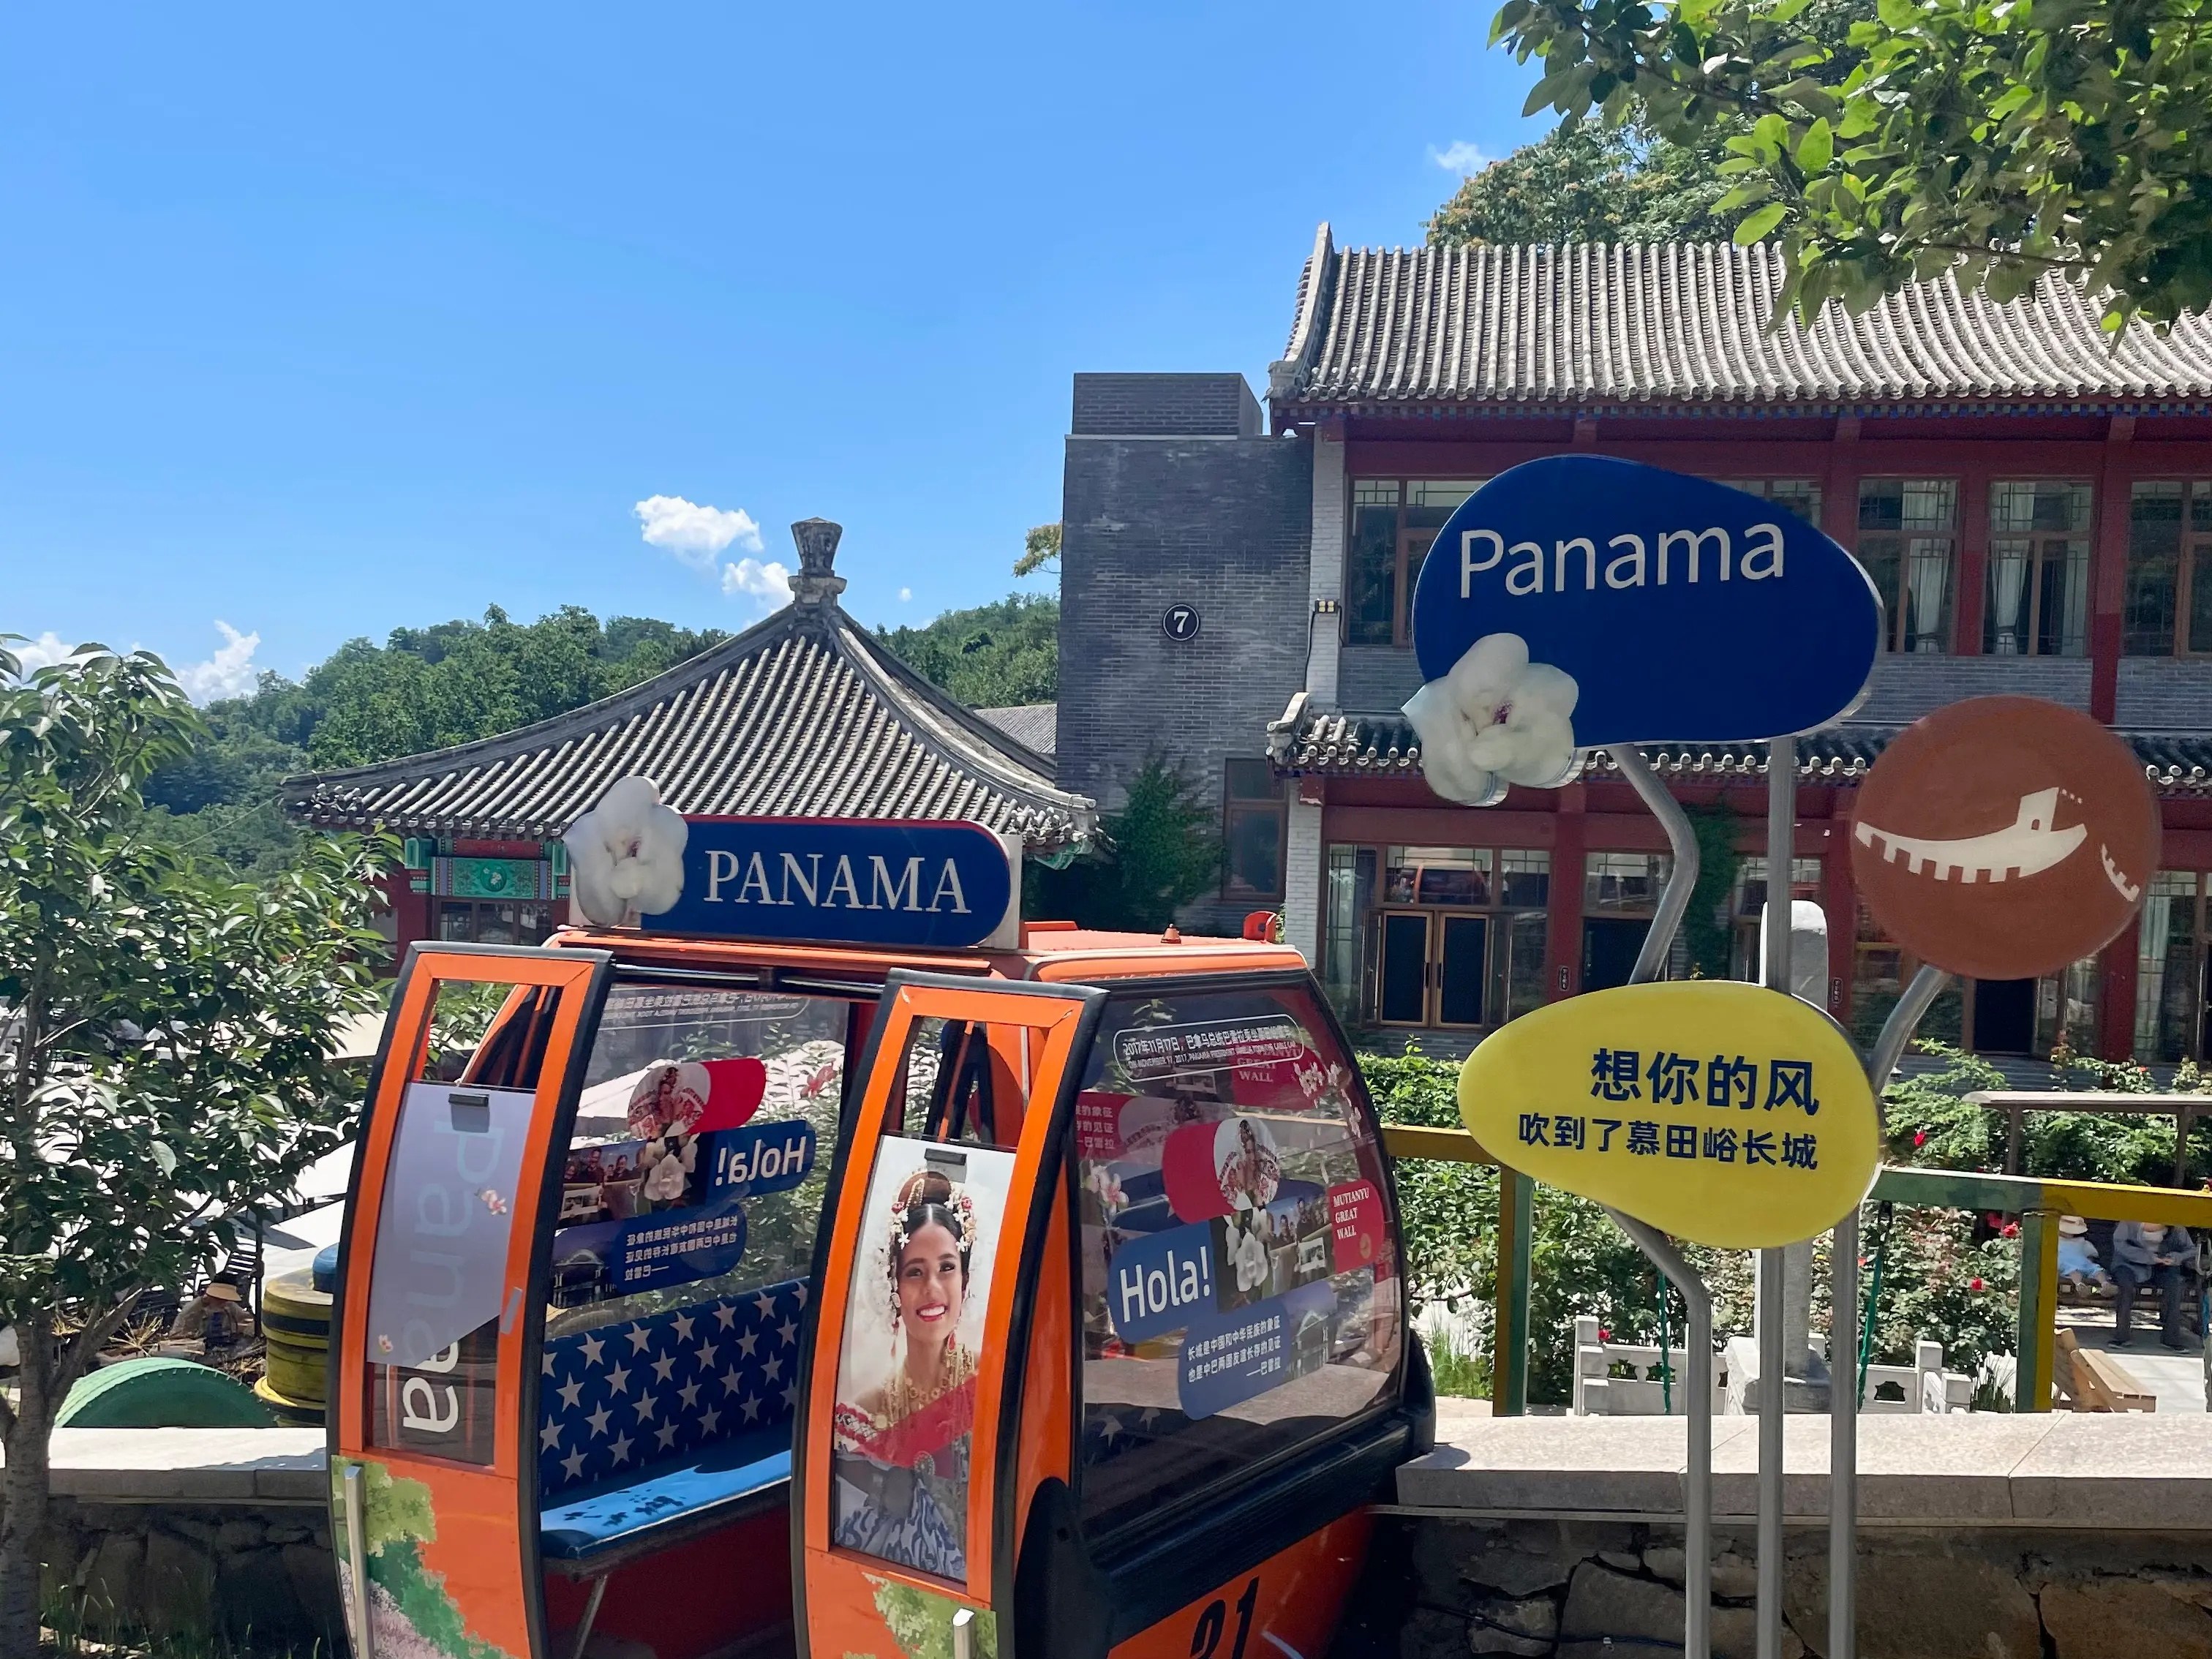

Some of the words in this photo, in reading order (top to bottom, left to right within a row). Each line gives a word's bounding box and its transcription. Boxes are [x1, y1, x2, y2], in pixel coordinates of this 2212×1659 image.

[1460, 523, 1784, 598] Panama
[1173, 611, 1189, 633] 7
[703, 850, 972, 914] PANAMA
[1238, 1070, 1274, 1083] WALL
[1590, 1047, 1820, 1116] 想你的风
[1519, 1113, 1818, 1170] 吹到了慕田峪长城
[1333, 1187, 1369, 1208] MUTIANYU
[1335, 1207, 1358, 1224] GREAT
[1336, 1225, 1357, 1240] WALL
[1120, 1246, 1211, 1323] Hola!
